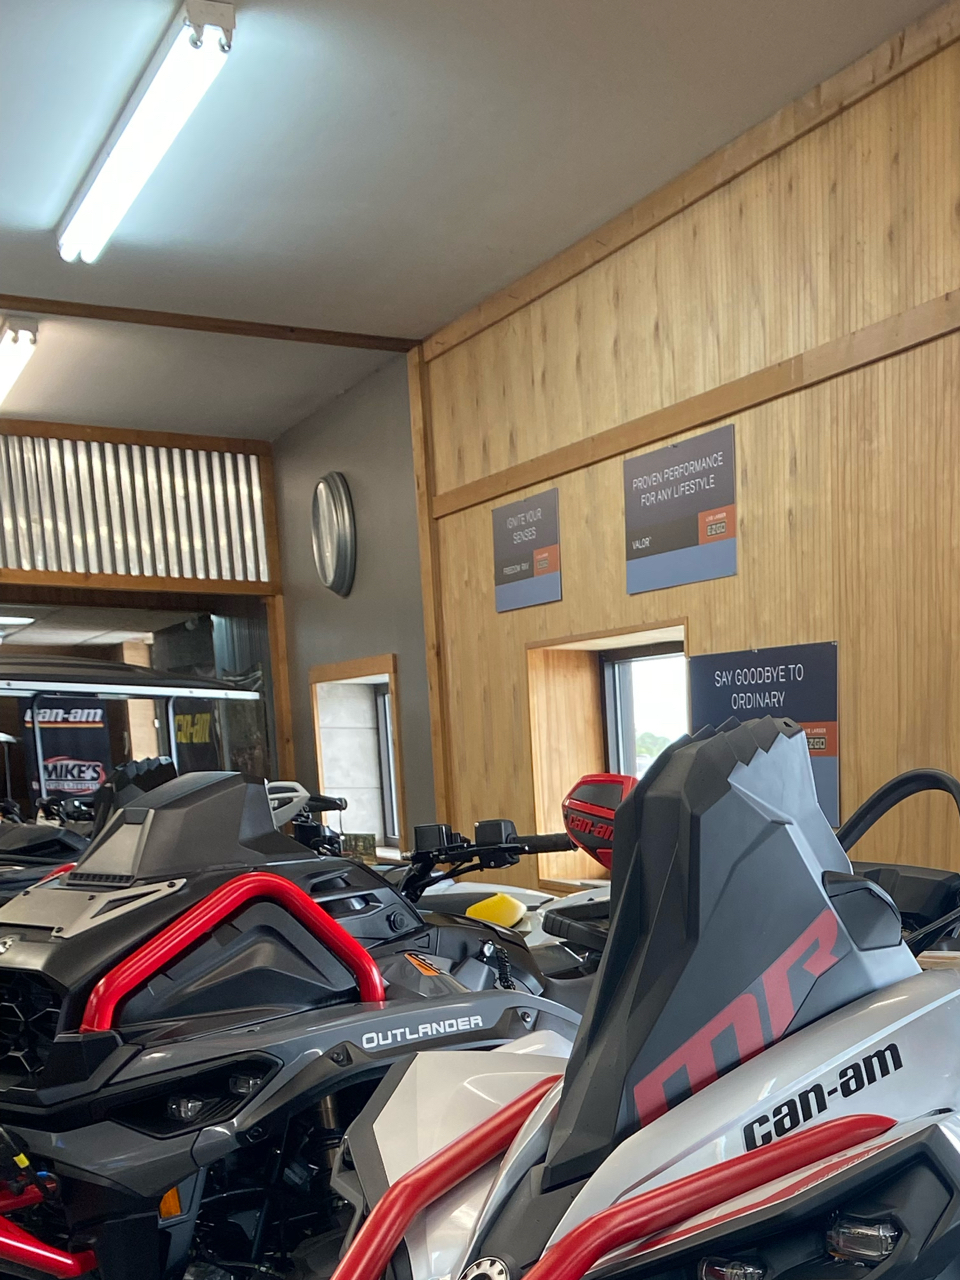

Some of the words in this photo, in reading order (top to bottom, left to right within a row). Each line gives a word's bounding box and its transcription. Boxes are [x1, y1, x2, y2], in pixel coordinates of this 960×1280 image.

[632, 472, 662, 491] PROVEN
[663, 452, 723, 481] PERFORMANCE
[641, 491, 656, 506] FOR
[657, 487, 672, 501] ANY
[673, 474, 715, 498] LIFESTYLE
[507, 513, 526, 528] IGNITE
[526, 508, 542, 522] YOUR
[513, 527, 536, 544] SENSES
[714, 670, 733, 687] SAY
[735, 665, 786, 686] GOODBYE
[788, 664, 804, 681] TO
[731, 691, 785, 709] ORDINARY
[362, 1015, 483, 1049] OUTLANDER
[743, 1042, 903, 1152] can-am
